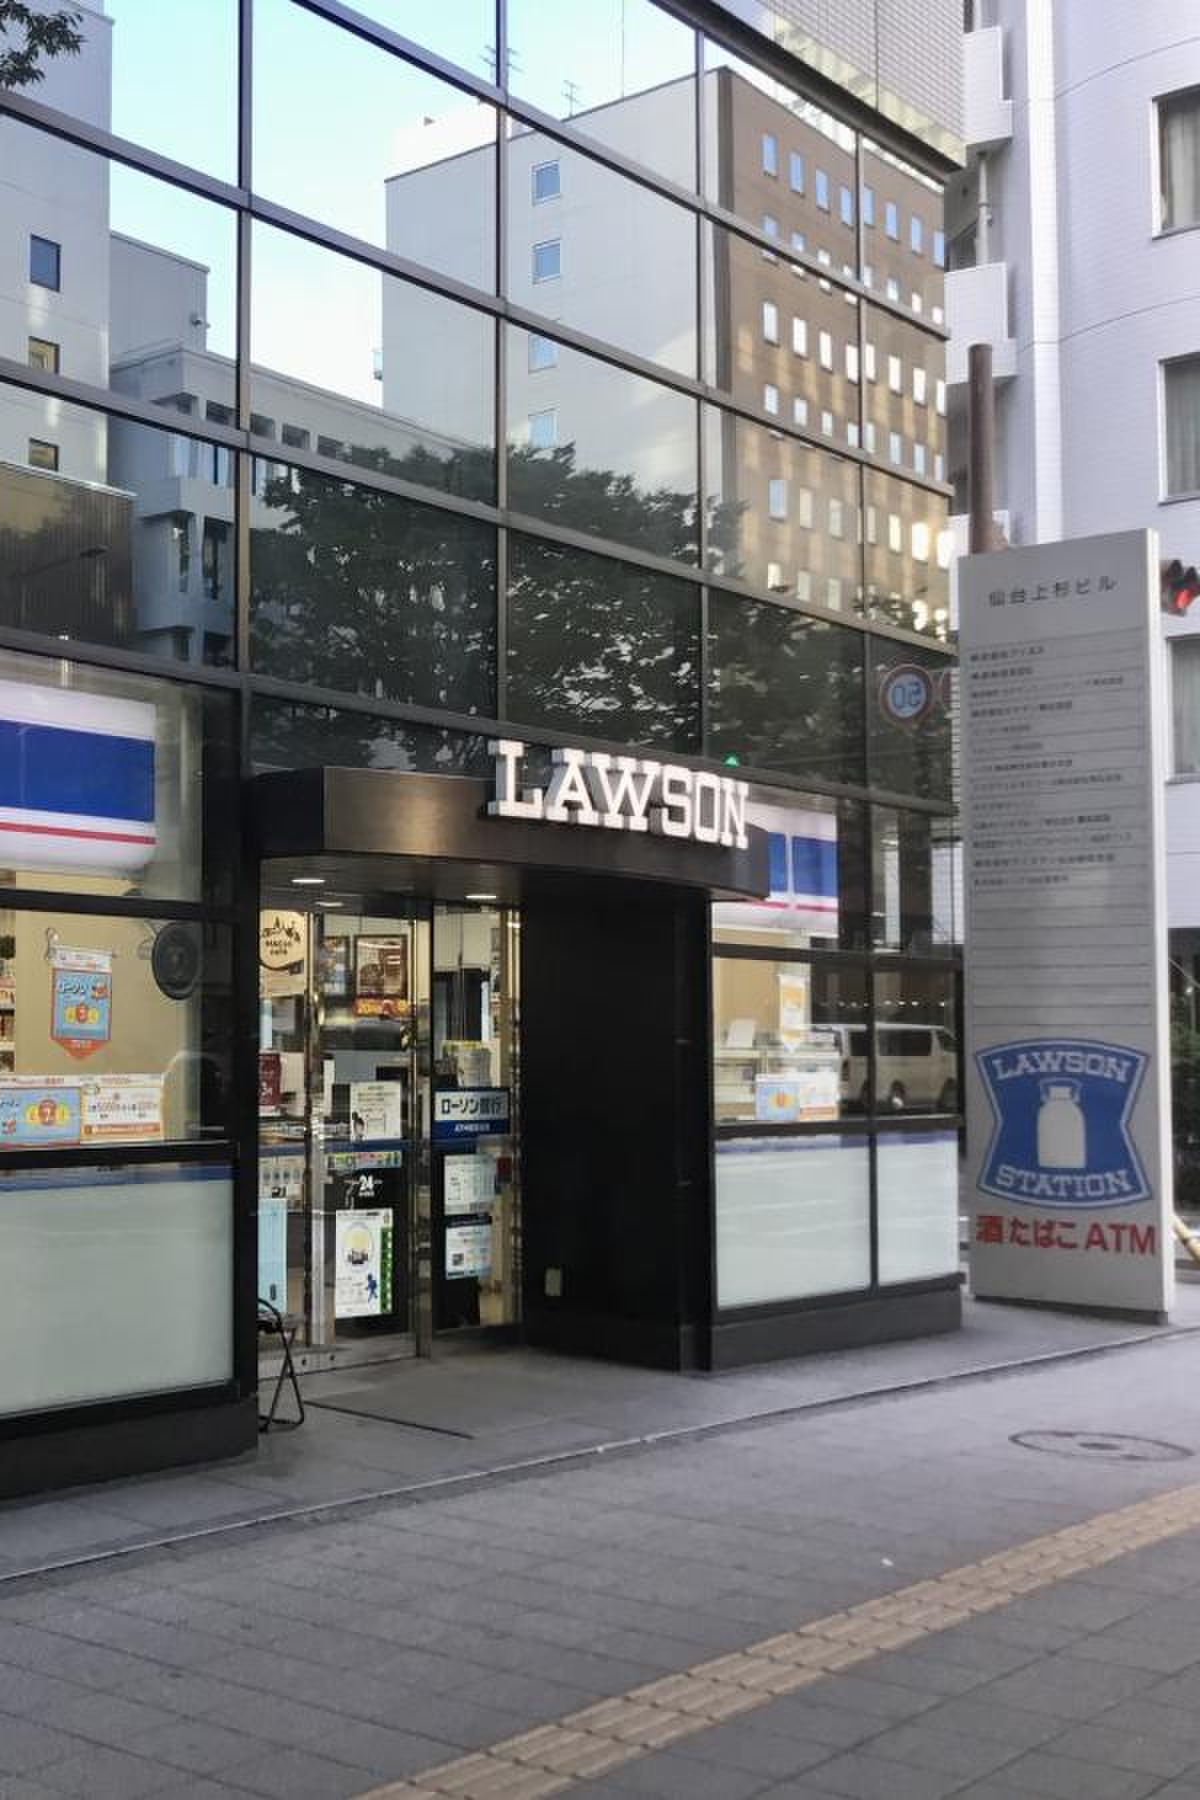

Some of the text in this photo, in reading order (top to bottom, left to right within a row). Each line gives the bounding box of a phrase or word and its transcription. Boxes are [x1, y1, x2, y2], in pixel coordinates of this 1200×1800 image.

[488, 740, 749, 849] LAWSON
[992, 1051, 1132, 1084] LAWSON
[995, 1165, 1134, 1200] STATION
[1084, 1222, 1157, 1257] ATM
